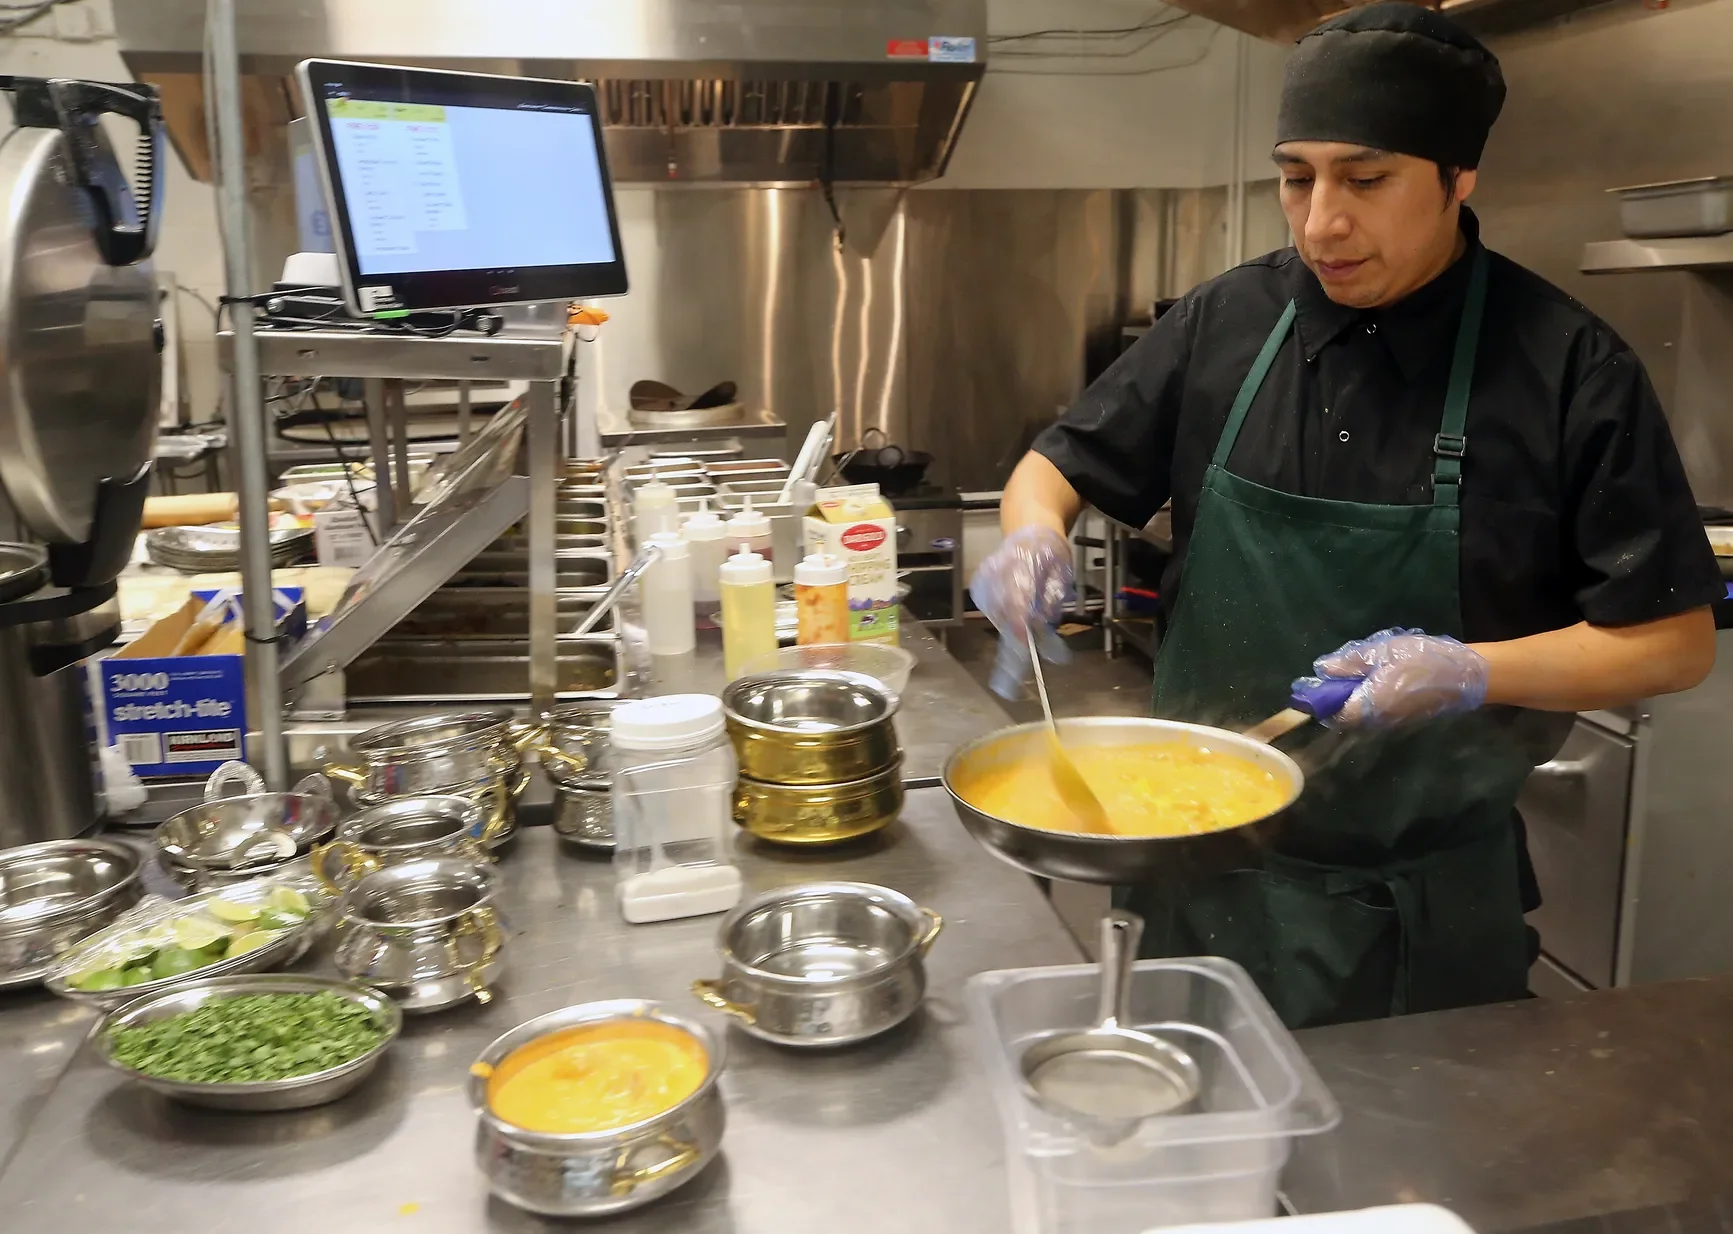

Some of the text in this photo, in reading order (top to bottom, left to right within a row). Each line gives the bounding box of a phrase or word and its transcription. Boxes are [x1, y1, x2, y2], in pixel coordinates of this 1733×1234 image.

[849, 573, 884, 586] CREAM
[110, 672, 169, 691] 3000
[113, 698, 232, 721] stretch-tite
